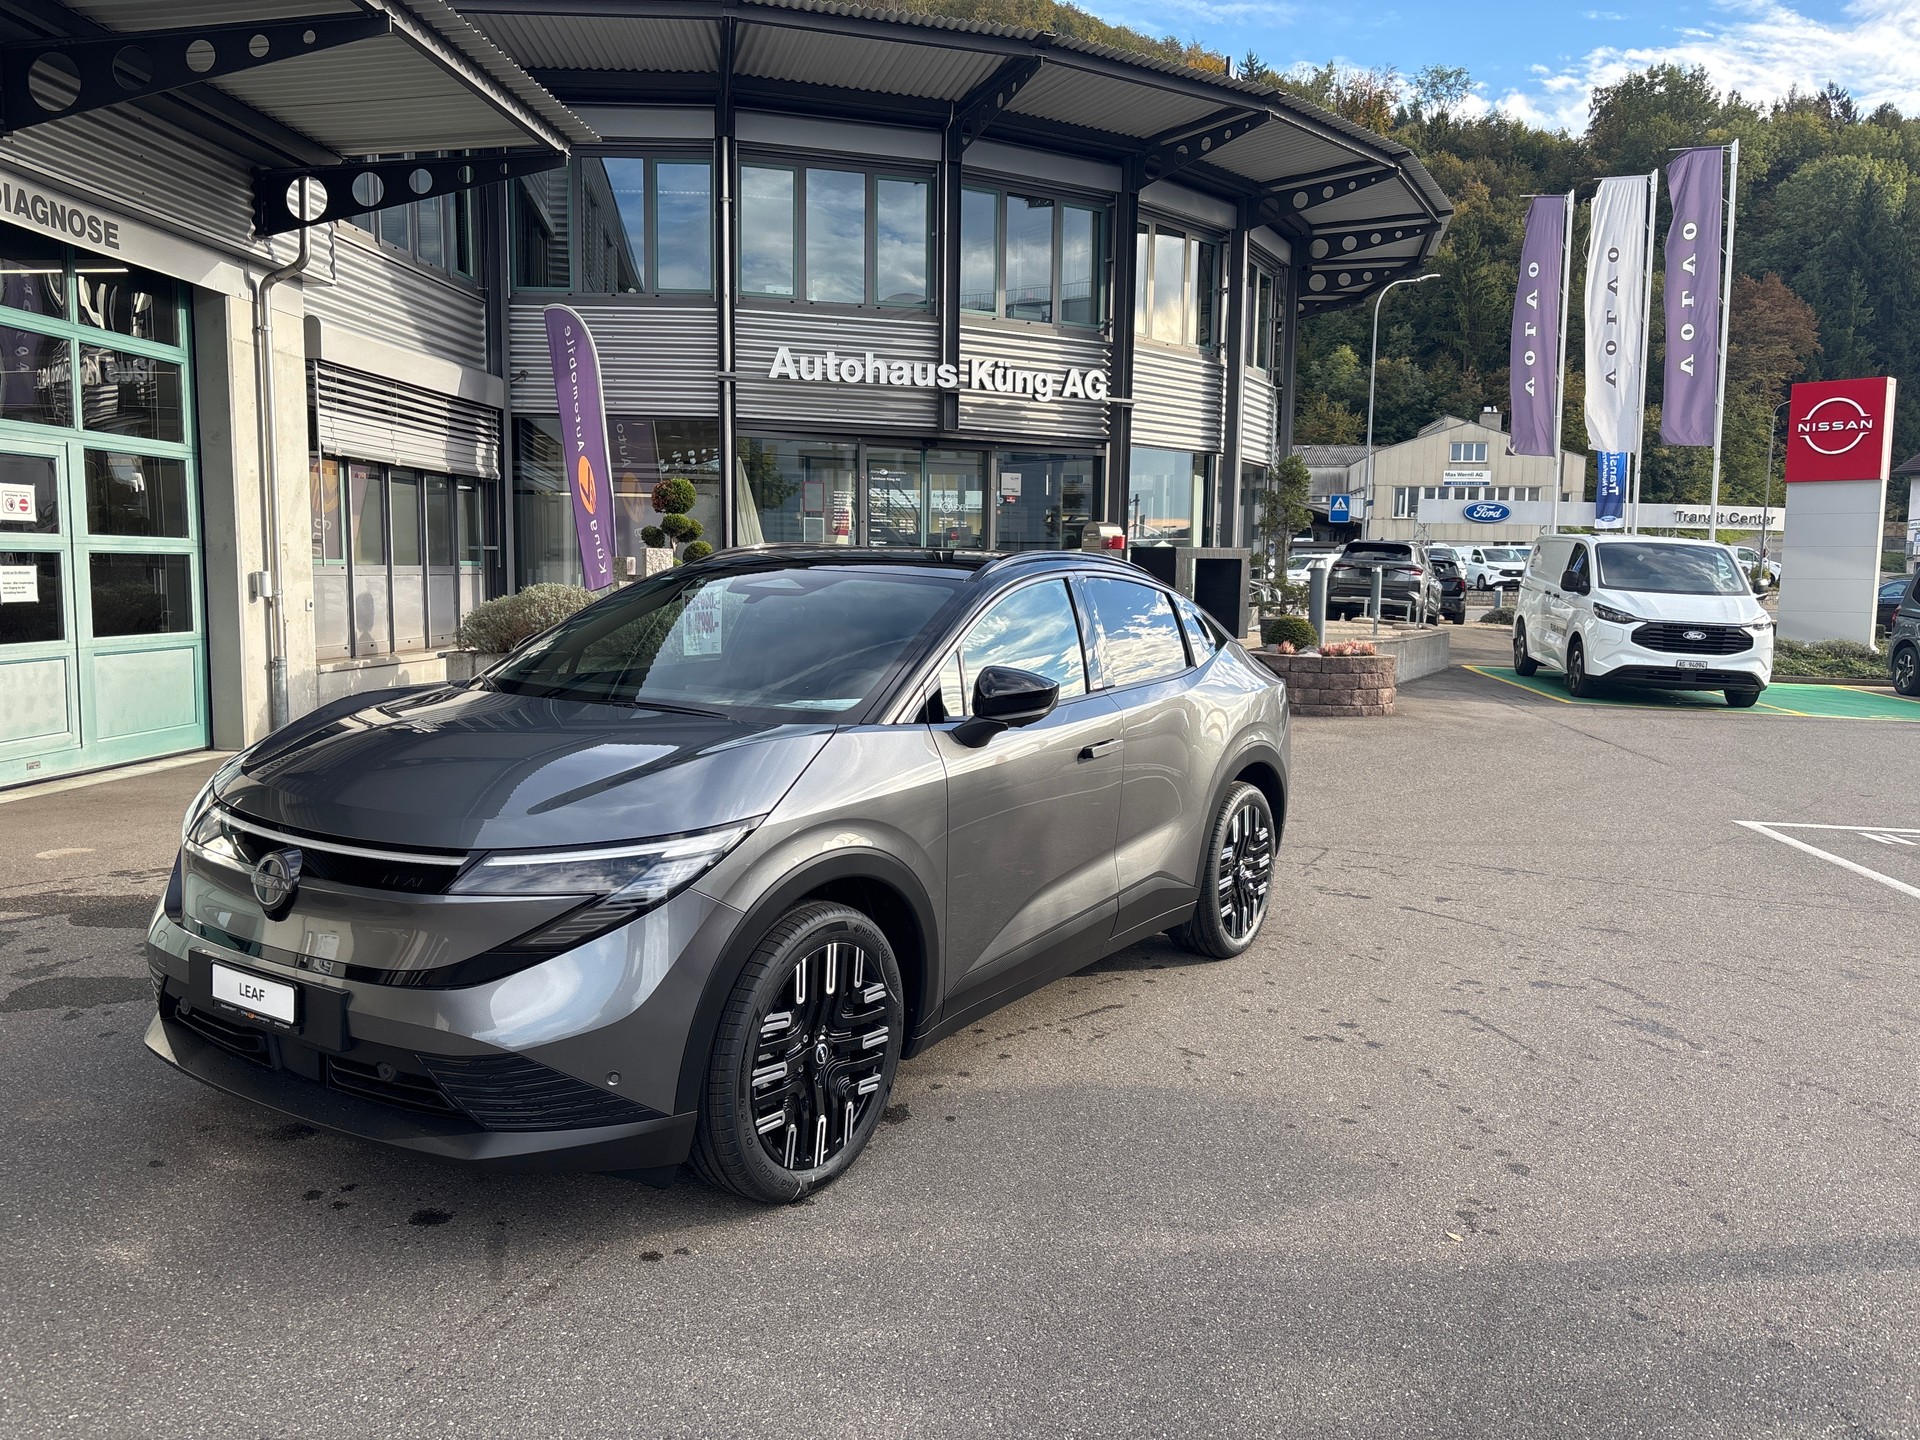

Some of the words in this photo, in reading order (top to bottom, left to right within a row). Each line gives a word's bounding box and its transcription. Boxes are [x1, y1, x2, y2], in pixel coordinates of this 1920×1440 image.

[0, 183, 120, 250] IAGNOSE
[768, 346, 958, 388] Autohaus
[970, 359, 1054, 402] Küng
[1061, 368, 1107, 400] AG
[1797, 419, 1874, 433] NISSAN
[1473, 504, 1503, 518] Ford
[1674, 510, 1725, 525] Transit
[1728, 512, 1777, 526] Center
[251, 872, 292, 891] NISSAN
[239, 982, 266, 1003] LEAF
